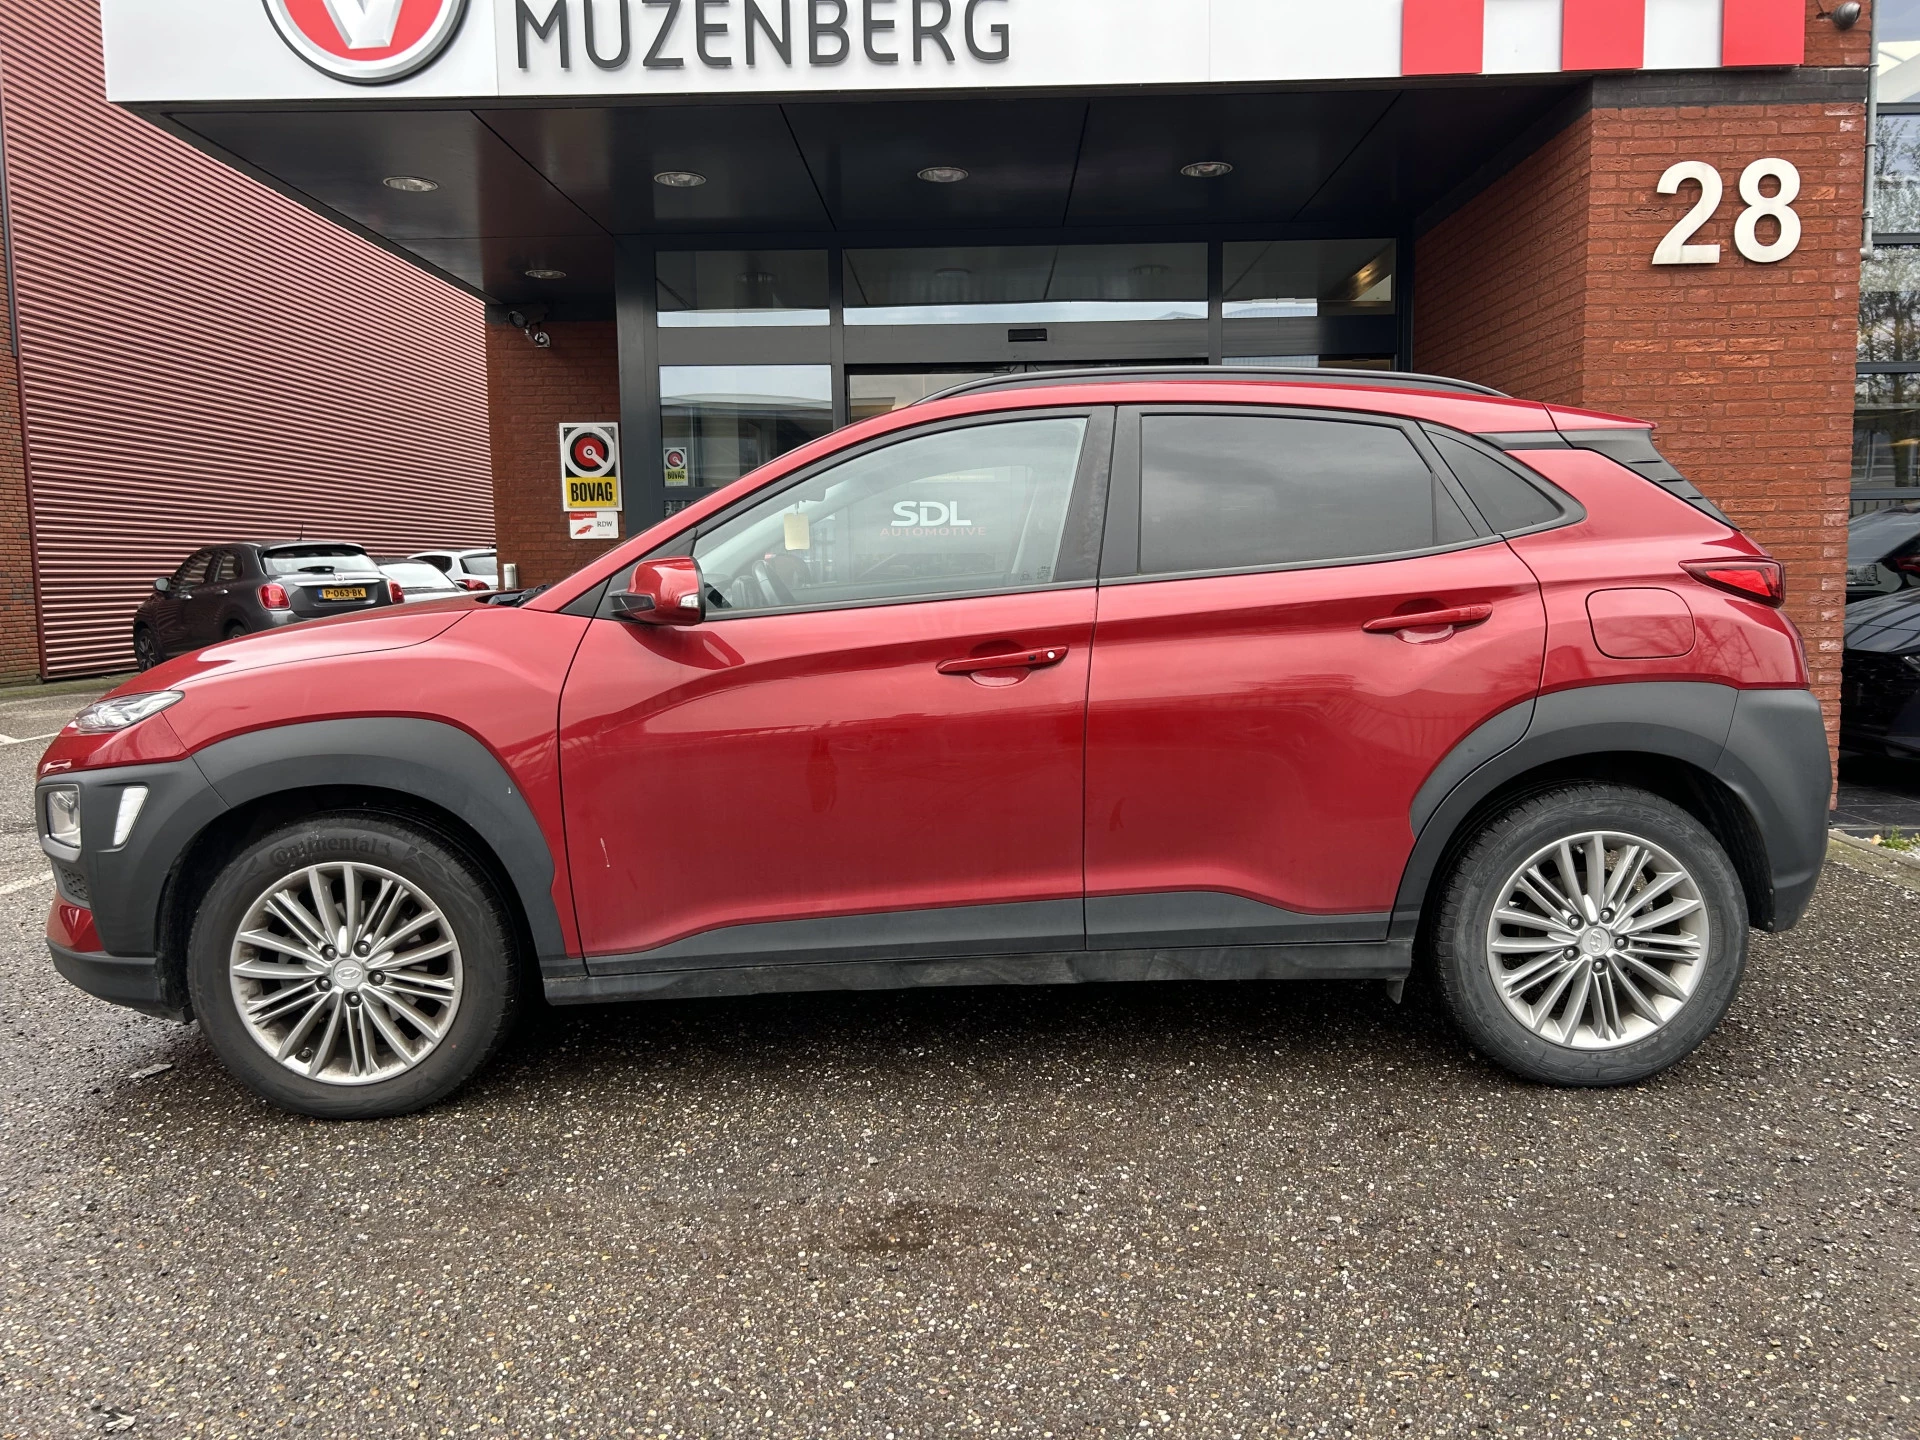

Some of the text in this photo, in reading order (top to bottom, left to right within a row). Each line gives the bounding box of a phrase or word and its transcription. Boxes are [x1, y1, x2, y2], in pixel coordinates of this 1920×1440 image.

[515, 0, 1011, 70] MUZENBERG
[1652, 157, 1801, 265] 28
[667, 471, 685, 479] BOVAG
[570, 482, 613, 501] BOVAG
[890, 500, 972, 527] SDL
[879, 527, 987, 537] AUTOMOTIVE
[325, 589, 363, 597] P-063-BK
